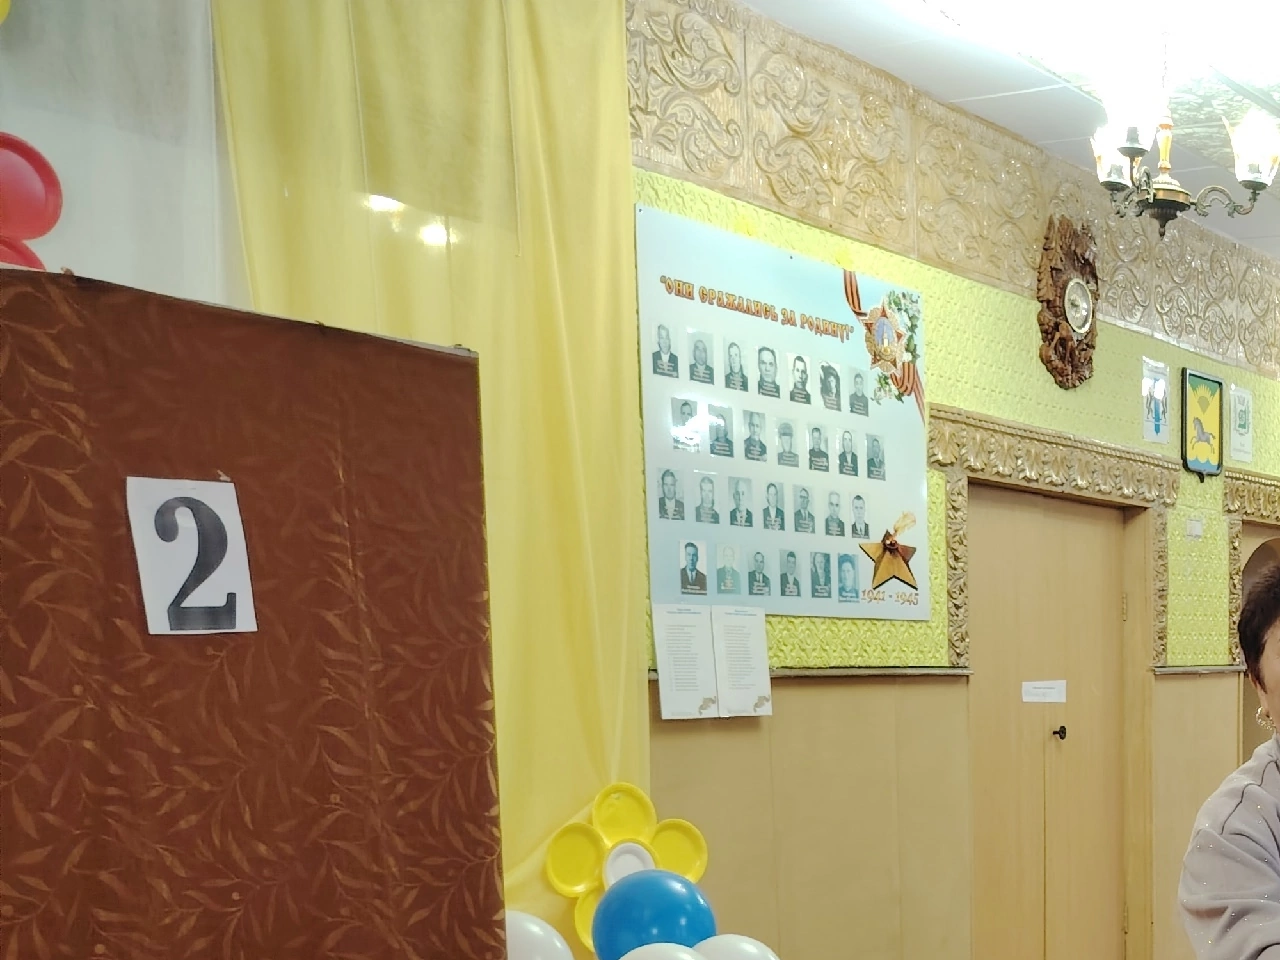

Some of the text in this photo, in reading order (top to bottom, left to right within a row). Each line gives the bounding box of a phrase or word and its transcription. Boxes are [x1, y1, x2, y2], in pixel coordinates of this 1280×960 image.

[699, 286, 778, 322] СРАЖАЛИСЬ
[781, 308, 797, 327] ЗА
[154, 496, 237, 631] 2
[861, 589, 886, 604] 1941
[894, 591, 919, 606] 1945
